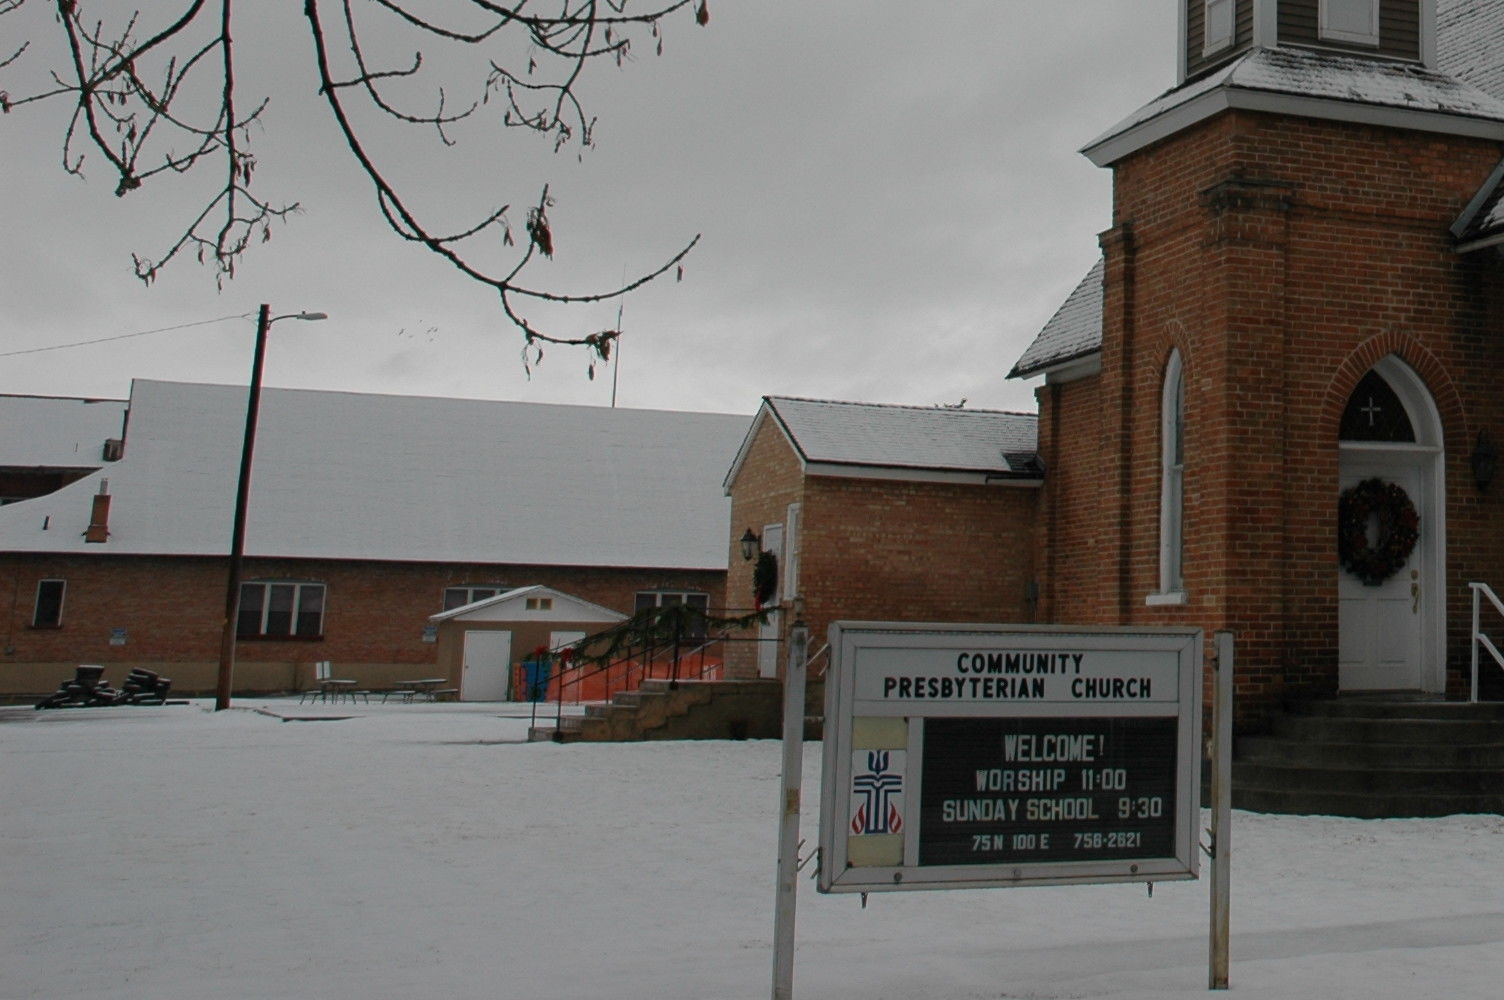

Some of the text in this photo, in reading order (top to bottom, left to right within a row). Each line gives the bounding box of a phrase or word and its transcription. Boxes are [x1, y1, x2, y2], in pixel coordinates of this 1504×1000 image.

[957, 653, 1084, 674] COMMUNITY
[884, 677, 1152, 699] PRESBYTERIAN CHURCH
[1004, 734, 1104, 762] WELCOME!
[976, 769, 1126, 791] WORSHIP 11:00
[942, 797, 1162, 822] SUNDAY SCHOOL 9:30
[1012, 833, 1036, 850] 100
